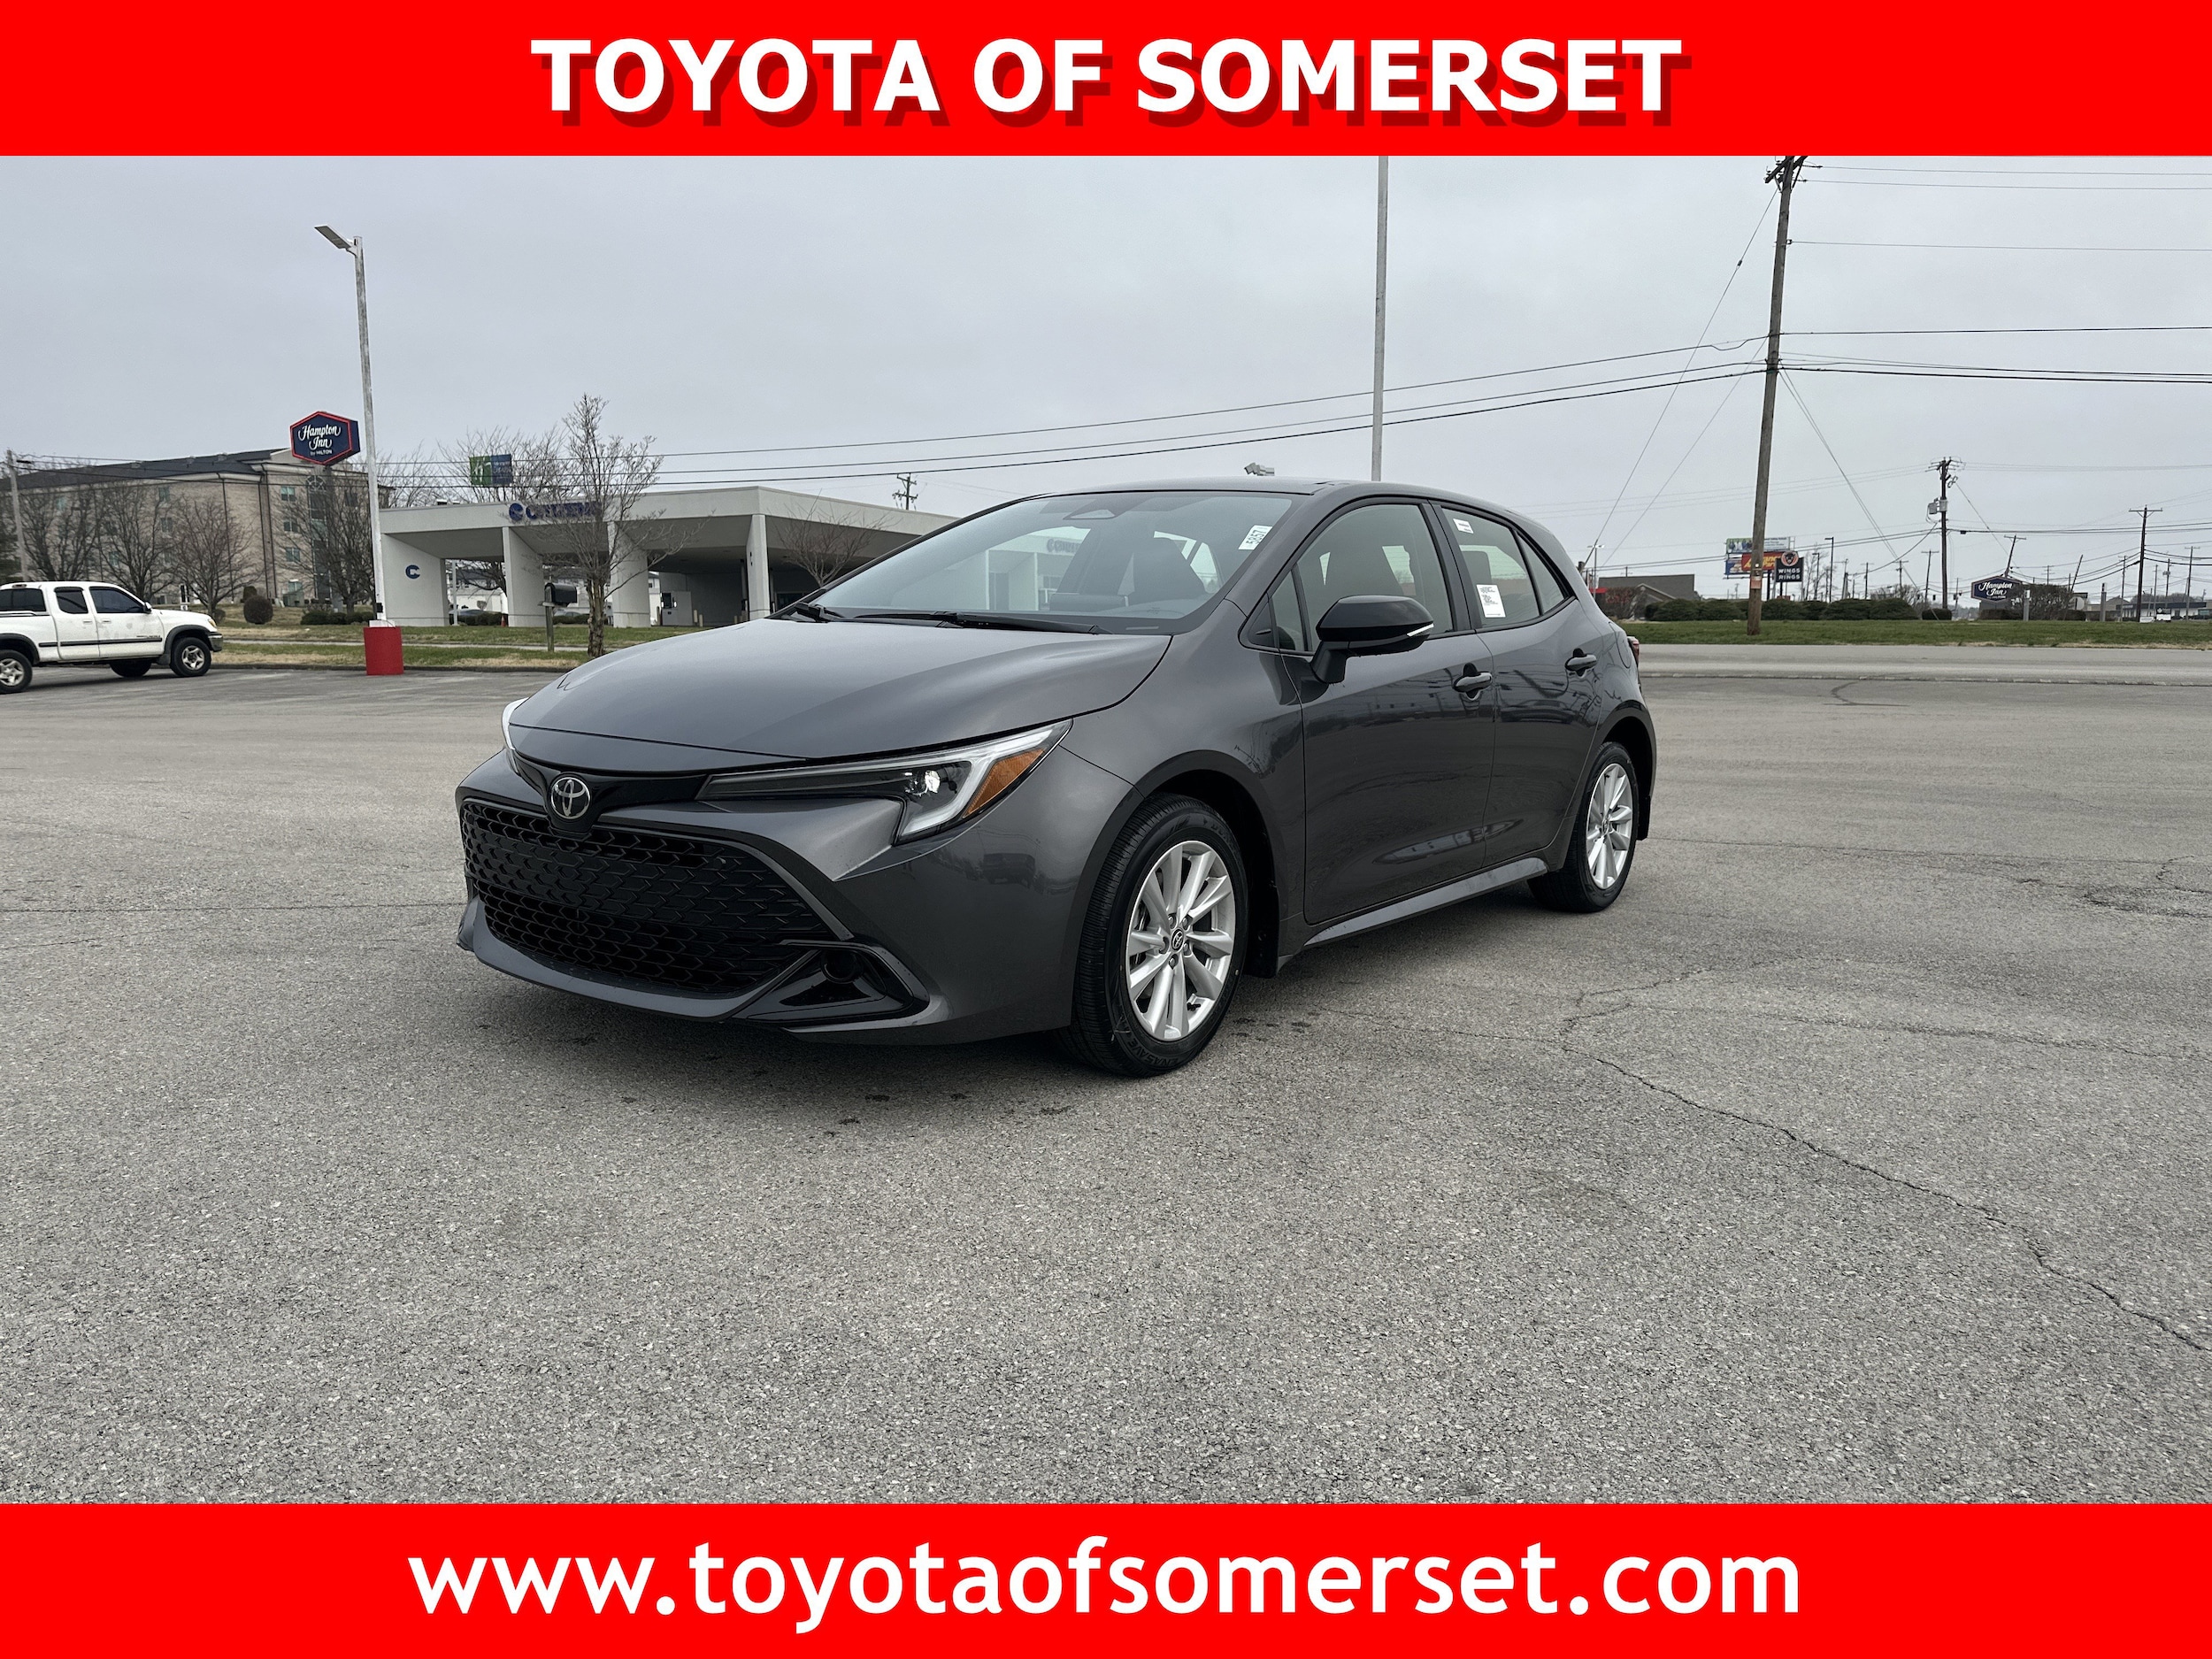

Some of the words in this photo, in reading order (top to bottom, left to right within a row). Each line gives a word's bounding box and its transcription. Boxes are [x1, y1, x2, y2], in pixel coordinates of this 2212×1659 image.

[298, 424, 342, 441] Hampton
[309, 436, 333, 450] Inn
[1978, 582, 2013, 591] Hampton
